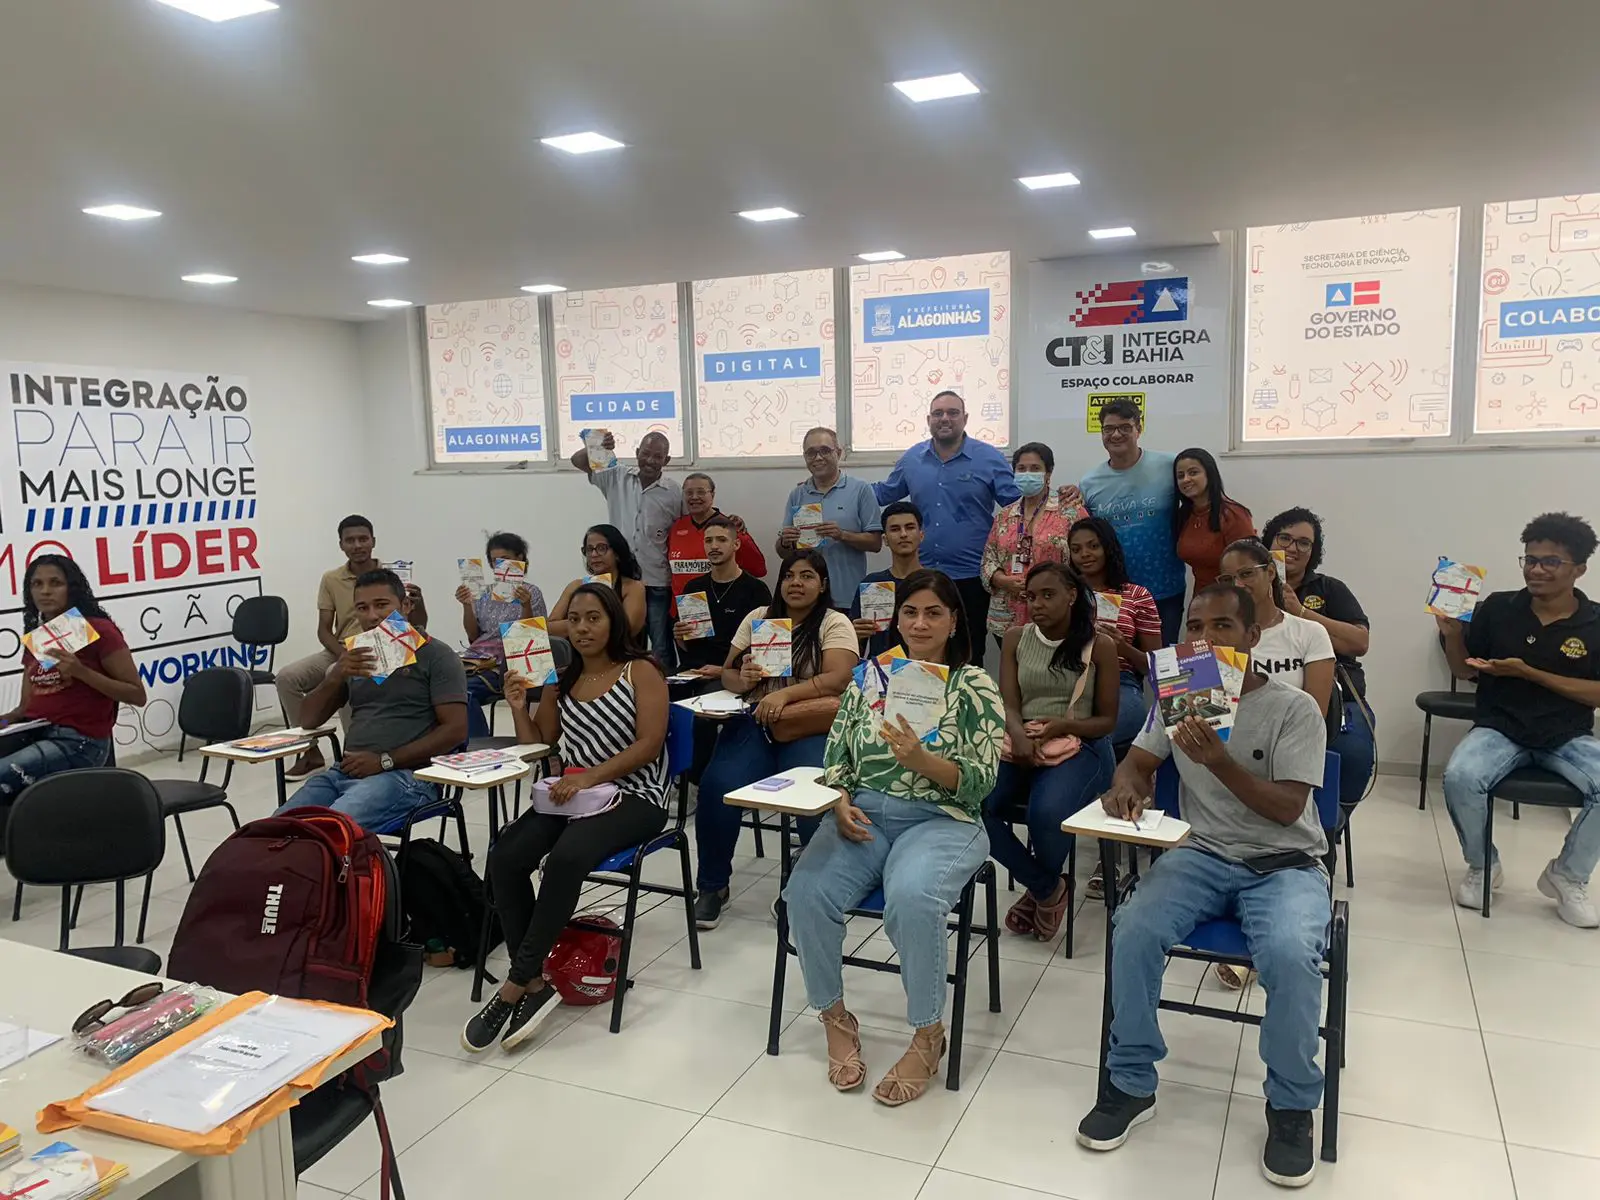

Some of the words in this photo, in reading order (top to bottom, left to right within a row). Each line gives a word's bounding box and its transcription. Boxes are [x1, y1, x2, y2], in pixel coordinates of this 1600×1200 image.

[1301, 260, 1355, 270] TECNOLOGIA
[1363, 254, 1410, 265] INOVAÇÃO
[1304, 251, 1354, 263] SECRETARIA
[1356, 250, 1368, 258] DE
[906, 303, 971, 313] PREFEITURA
[1310, 308, 1397, 325] GOVERNO
[1504, 306, 1600, 327] COLABO
[898, 309, 982, 329] ALAGOINHAS
[1122, 328, 1211, 348] INTEGRA
[1304, 327, 1331, 340] DO
[1333, 322, 1401, 339] ESTADO
[1045, 334, 1114, 367] CT&I
[1122, 346, 1184, 364] BAHIA
[715, 356, 808, 374] DIGITAL
[1061, 376, 1110, 389] ESPAÇO
[1112, 373, 1194, 386] COLABORAR
[10, 373, 248, 419] INTEGRAÇÃO
[585, 399, 660, 414] CIDADE
[14, 409, 194, 467] PARA
[209, 415, 254, 465] IR
[448, 431, 539, 446] ALAGOINHAS
[19, 469, 126, 504] MAIS
[135, 466, 257, 500] LONGE
[261, 884, 284, 934] THULE
